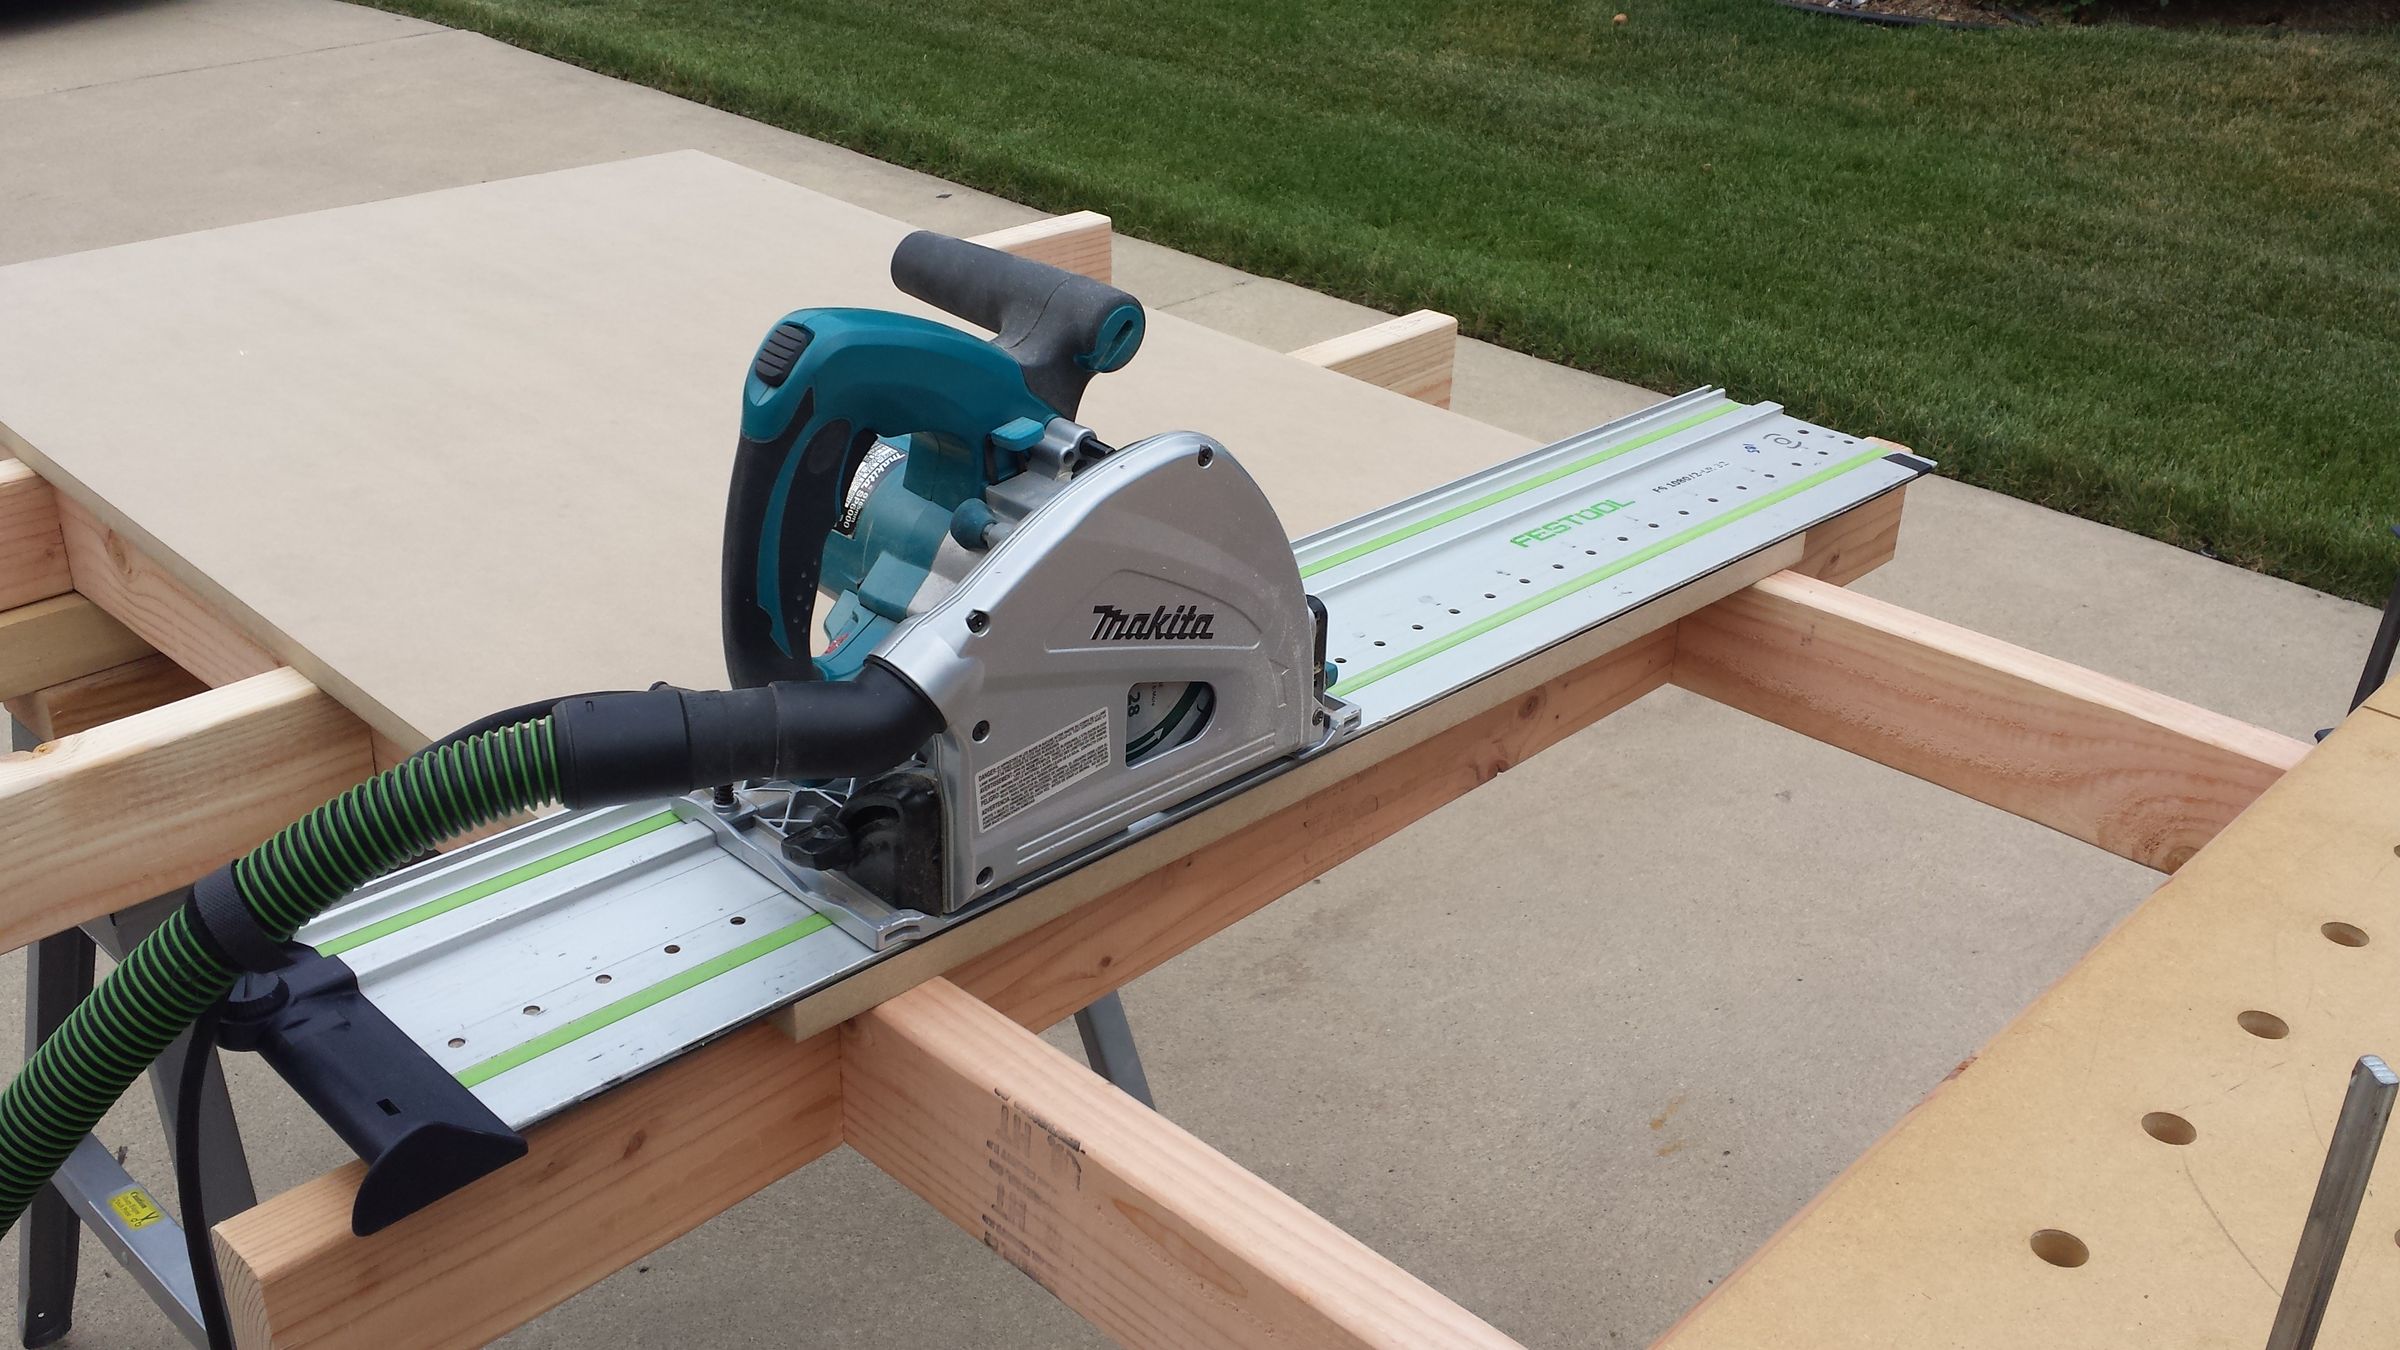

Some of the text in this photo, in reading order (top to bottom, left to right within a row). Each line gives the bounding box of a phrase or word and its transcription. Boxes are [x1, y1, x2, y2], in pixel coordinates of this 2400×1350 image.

[861, 452, 905, 489] Makita
[843, 489, 864, 528] SP6000
[1510, 499, 1636, 548] FESTOOL
[1090, 605, 1215, 641] Makita
[1127, 691, 1141, 718] 28
